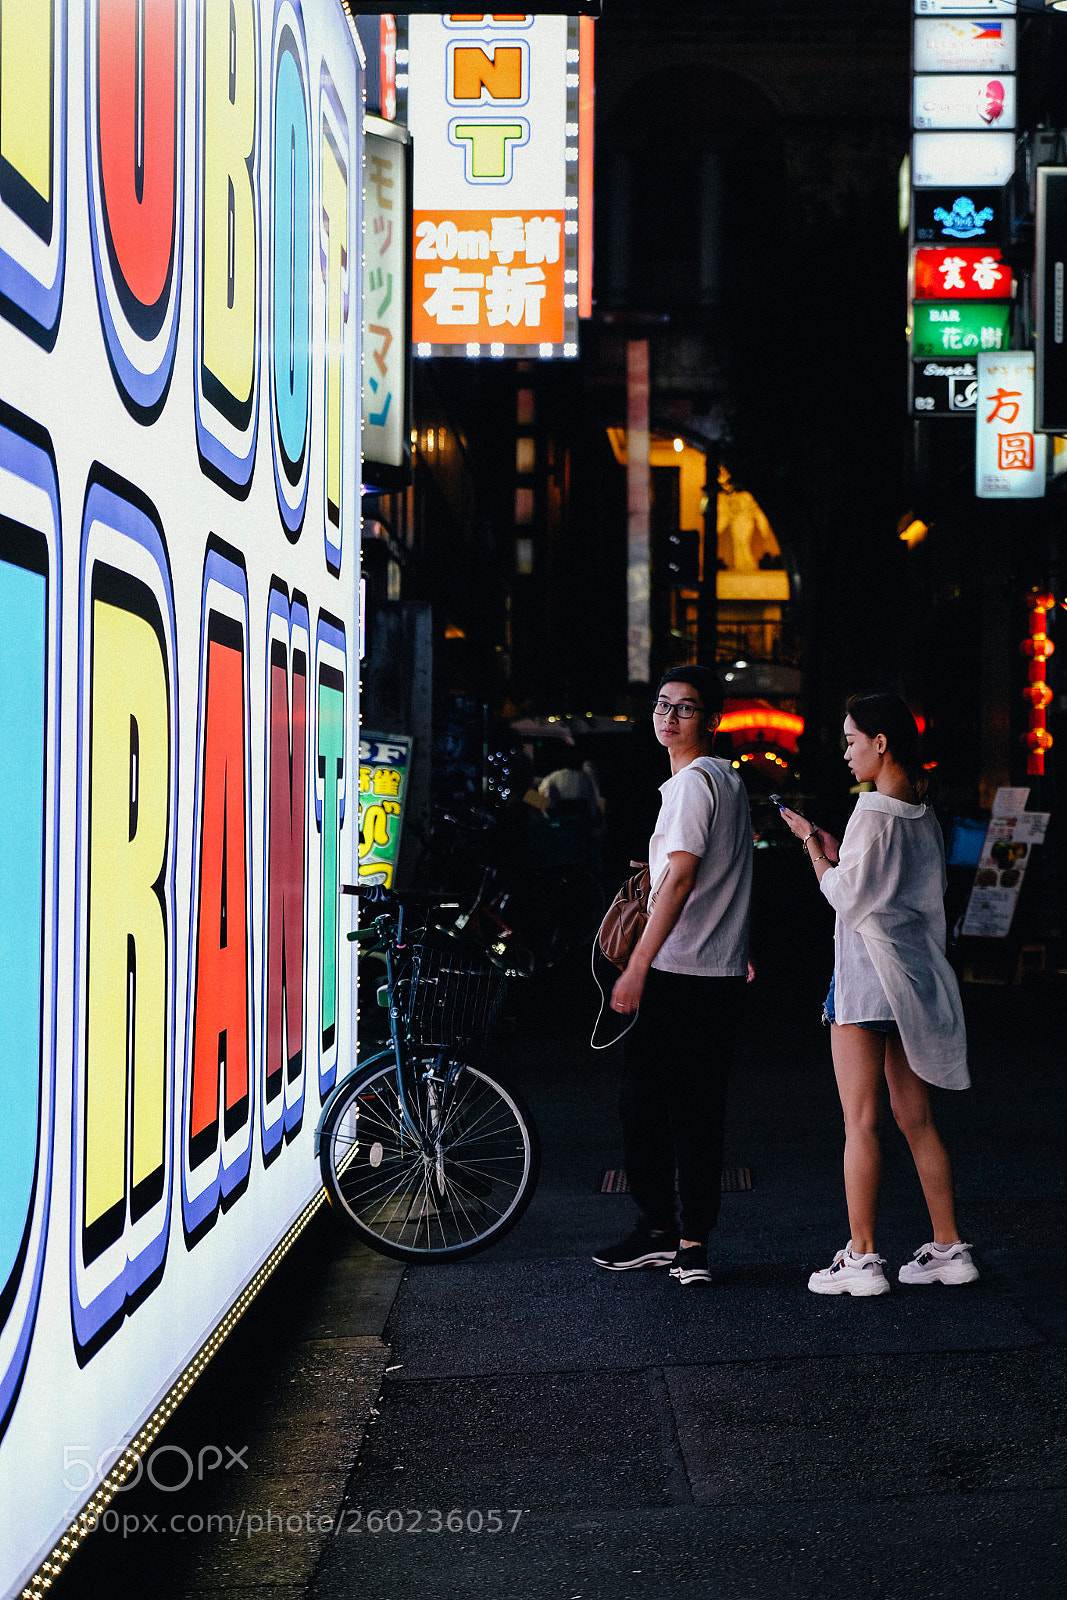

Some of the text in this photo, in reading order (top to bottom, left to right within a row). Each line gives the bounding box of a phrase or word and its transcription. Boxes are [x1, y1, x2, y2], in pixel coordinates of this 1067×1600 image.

[442, 14, 532, 185] NT
[415, 216, 561, 264] 20m手前
[422, 266, 546, 327] 右折
[929, 309, 961, 322] BAR
[941, 326, 1003, 350] 花の樹
[0, 395, 348, 1446] RANT
